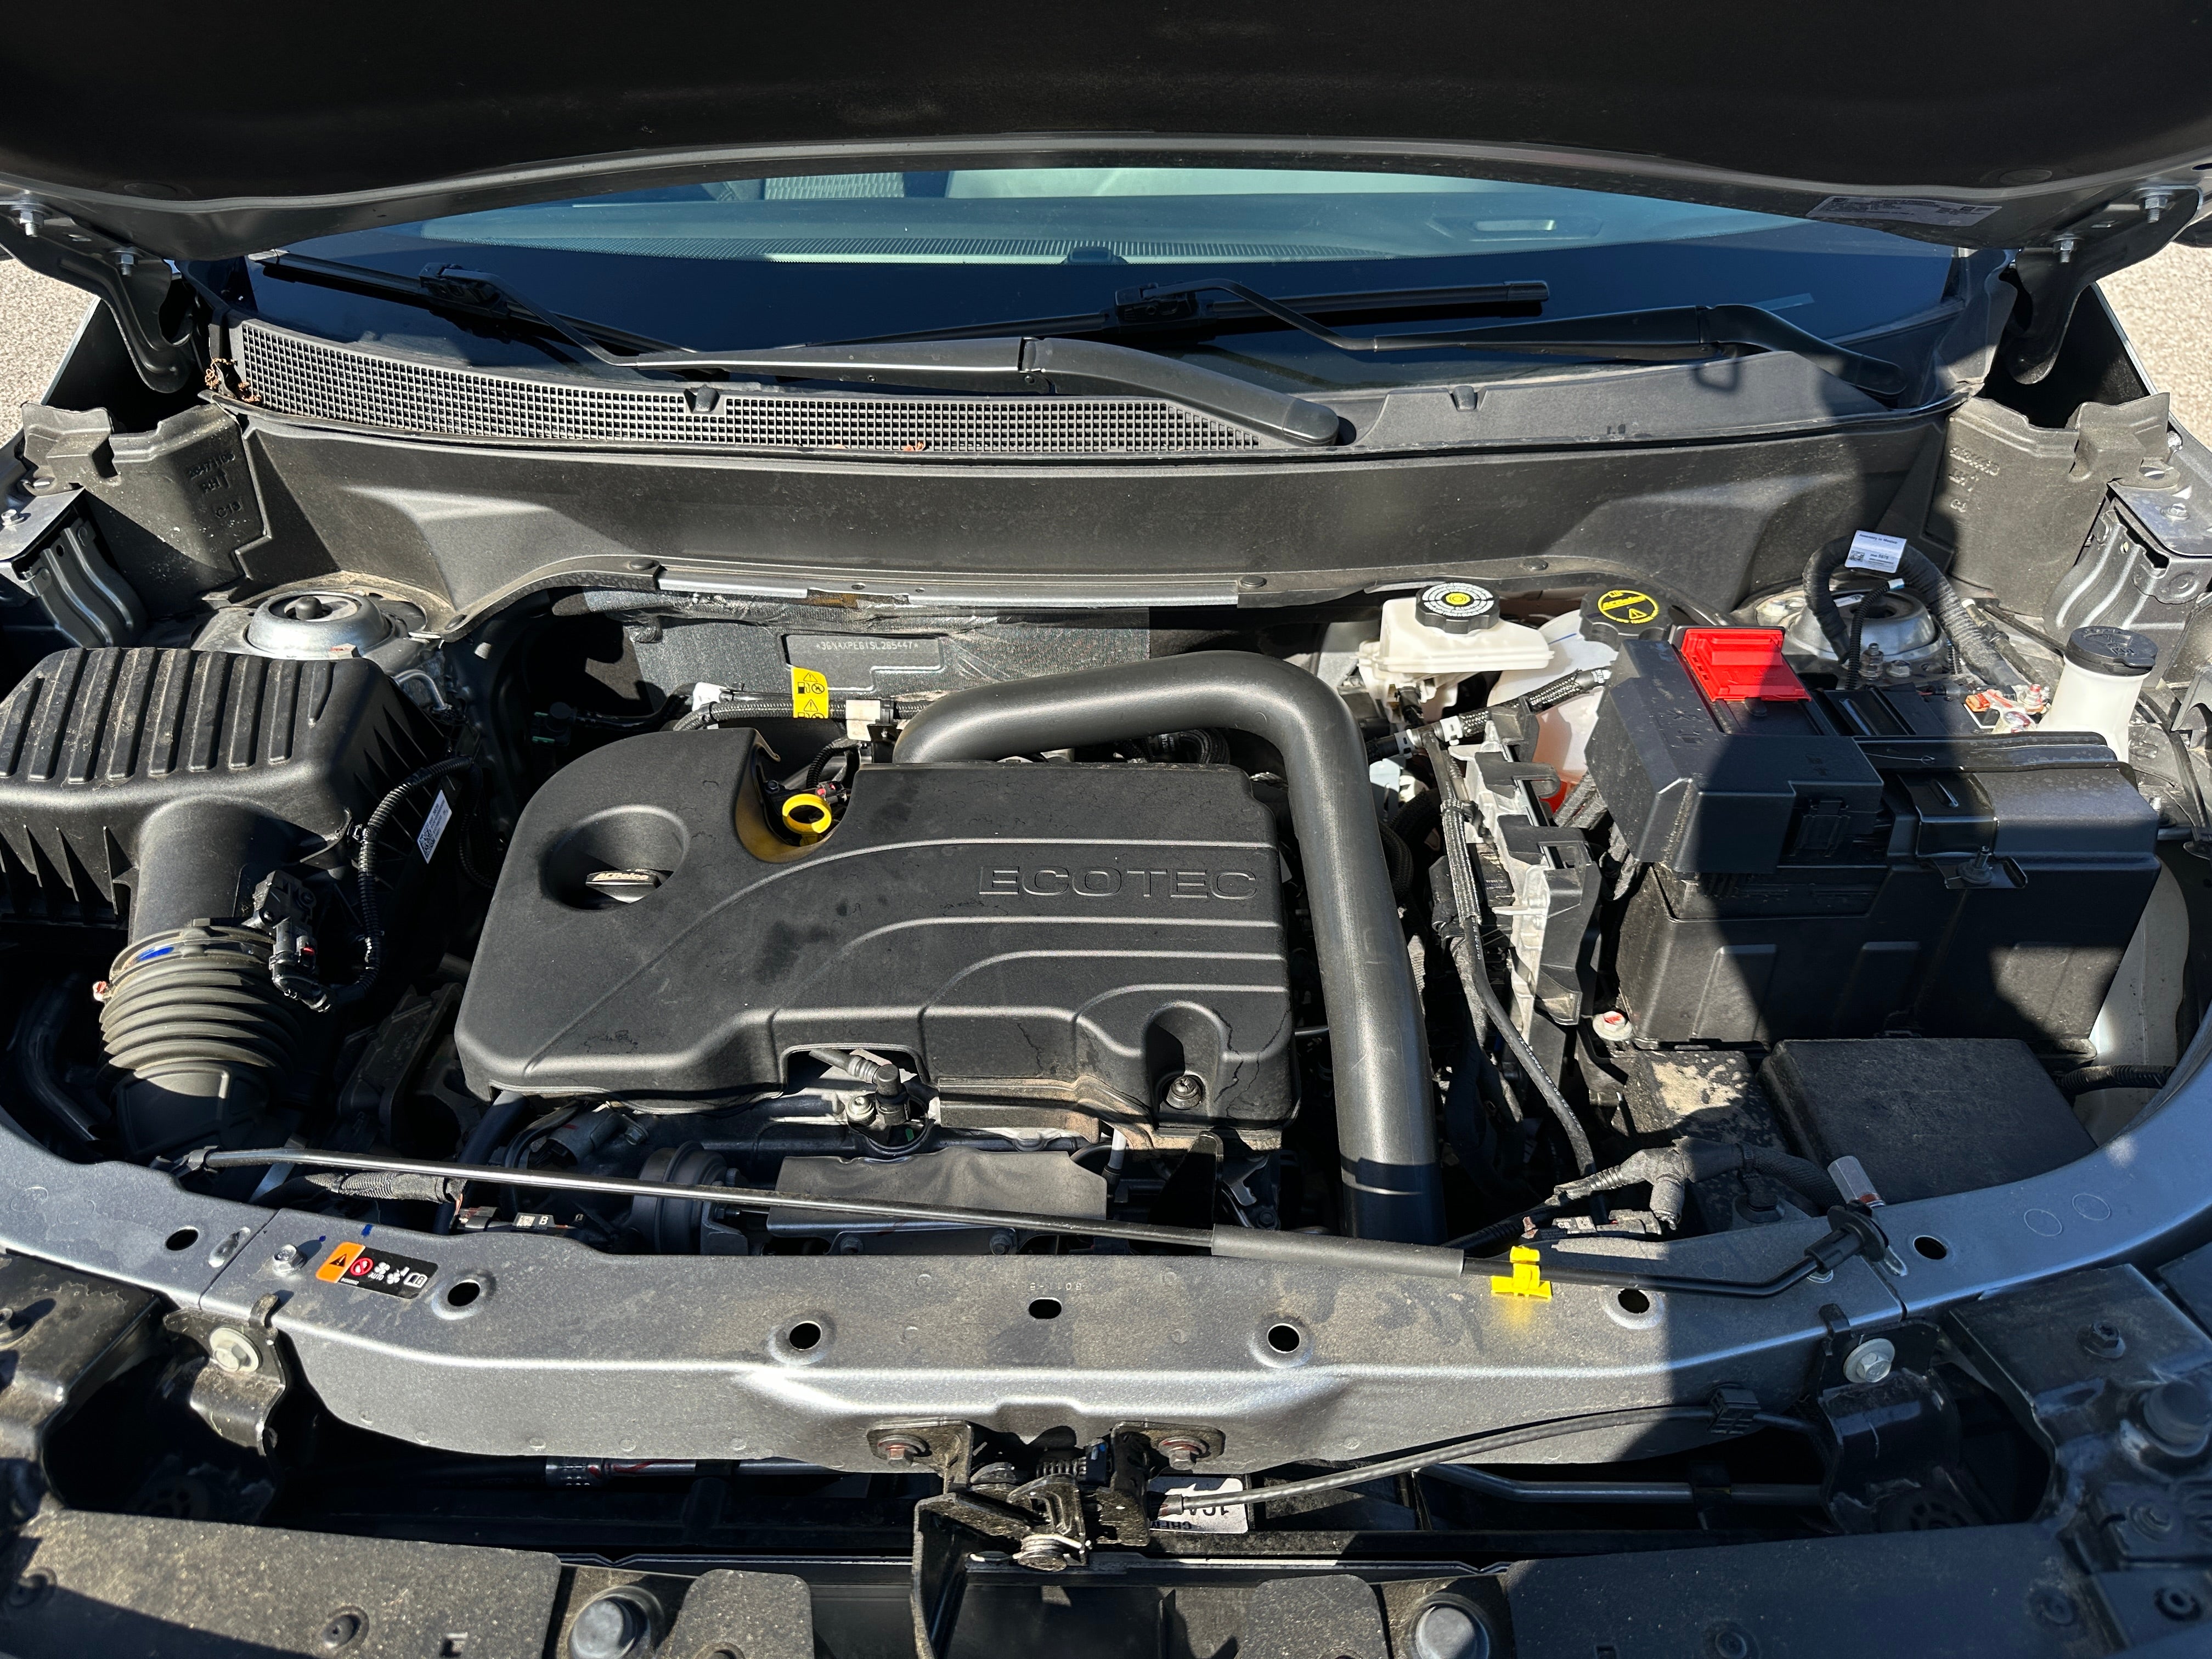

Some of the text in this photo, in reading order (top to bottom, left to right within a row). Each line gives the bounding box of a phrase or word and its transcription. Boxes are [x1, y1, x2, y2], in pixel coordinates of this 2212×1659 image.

[978, 866, 1257, 900] ECOTEC
[538, 1216, 549, 1225] B
[368, 1272, 385, 1282] AUTO
